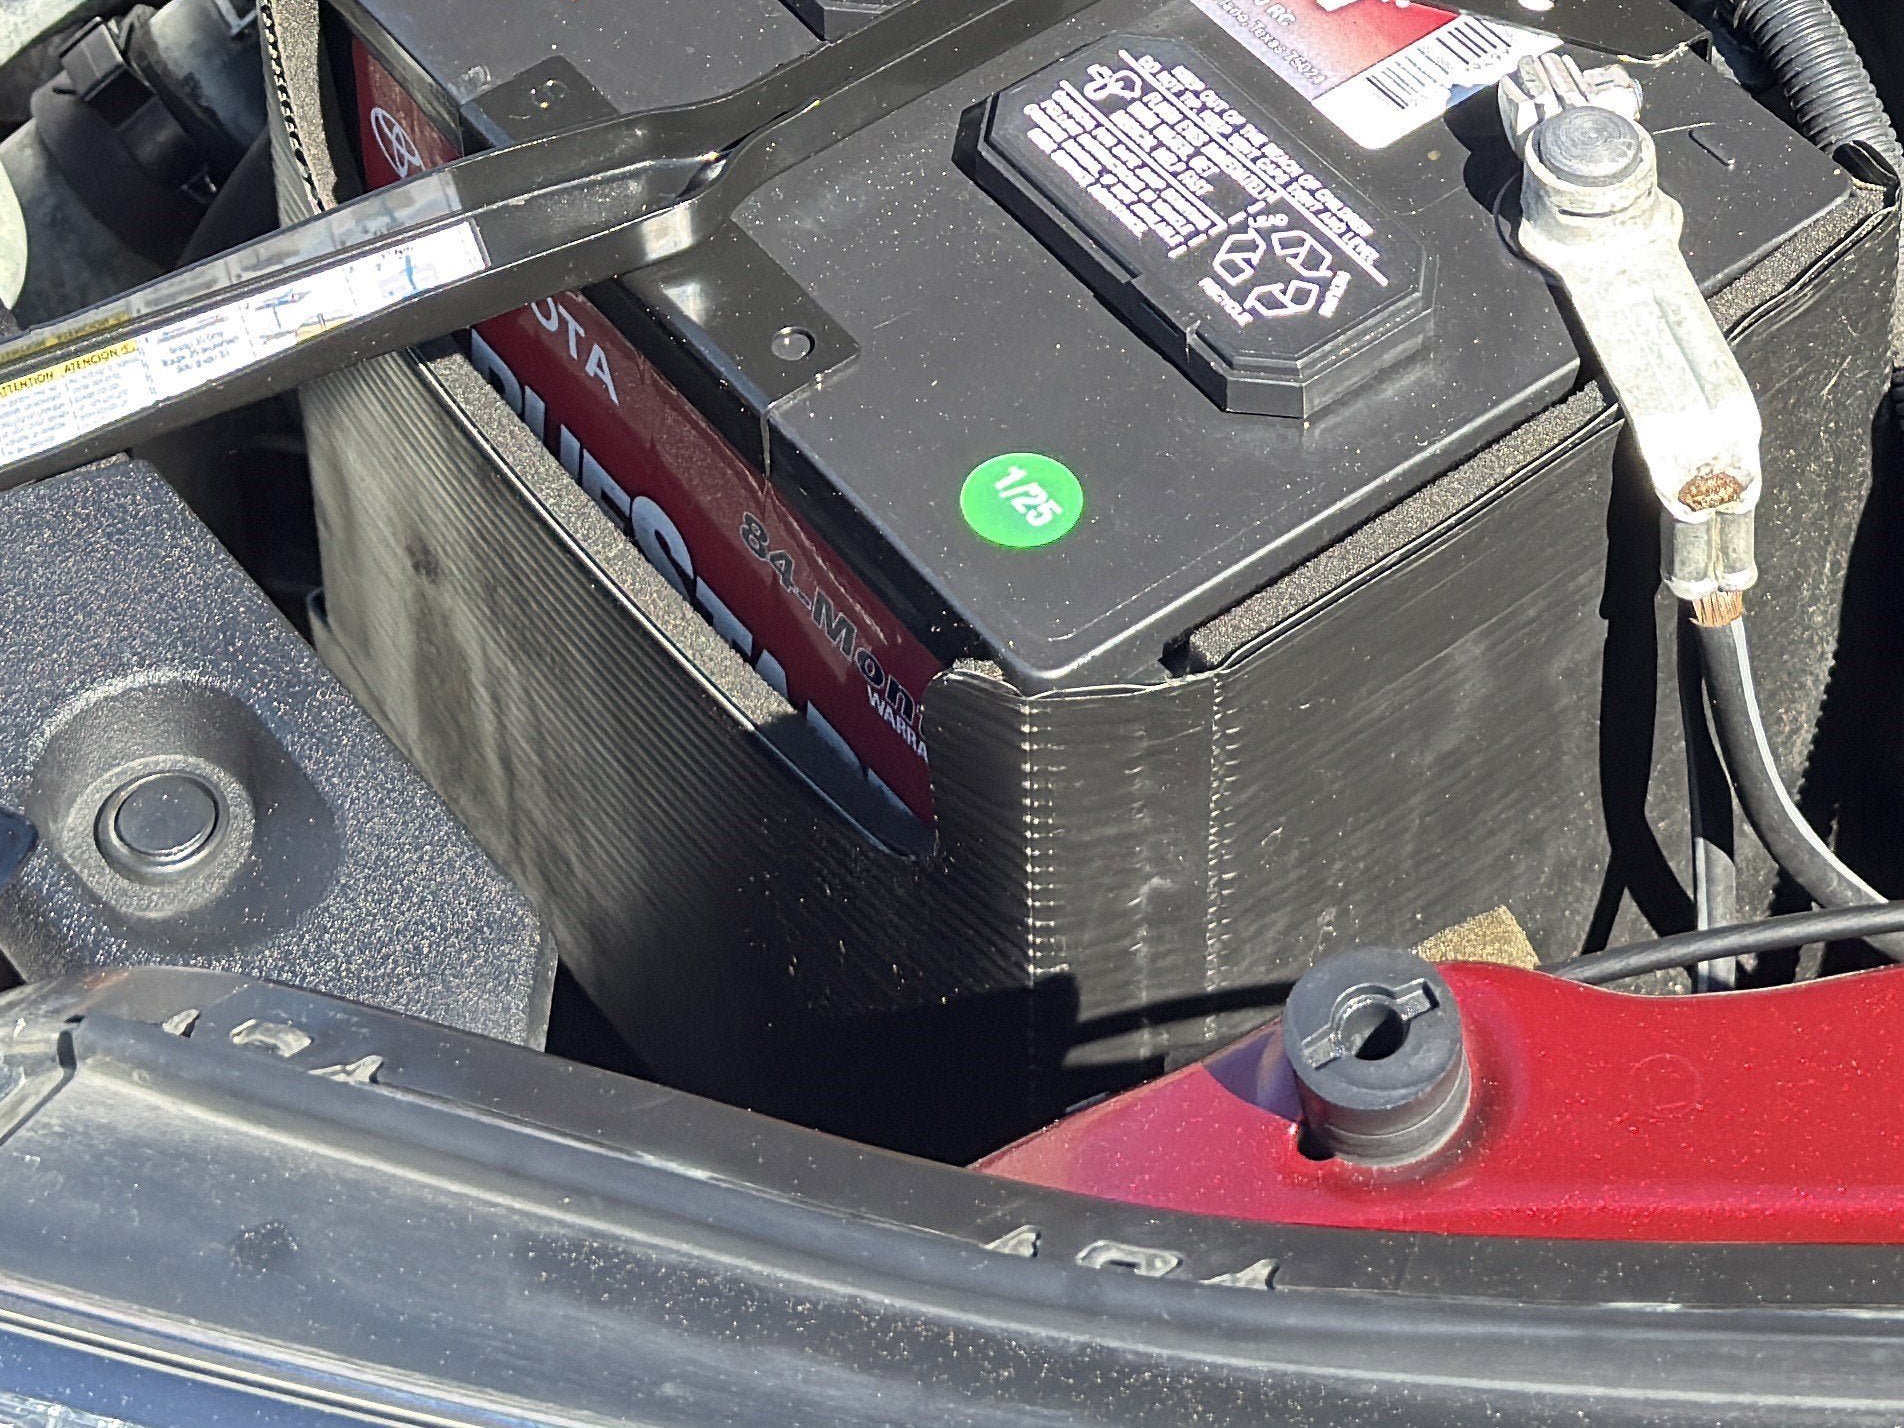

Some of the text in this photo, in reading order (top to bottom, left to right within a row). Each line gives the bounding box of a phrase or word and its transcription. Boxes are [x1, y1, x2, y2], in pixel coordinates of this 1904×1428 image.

[1249, 19, 1286, 55] Texas
[1248, 213, 1289, 228] LEAD
[994, 465, 1063, 527] 1/25
